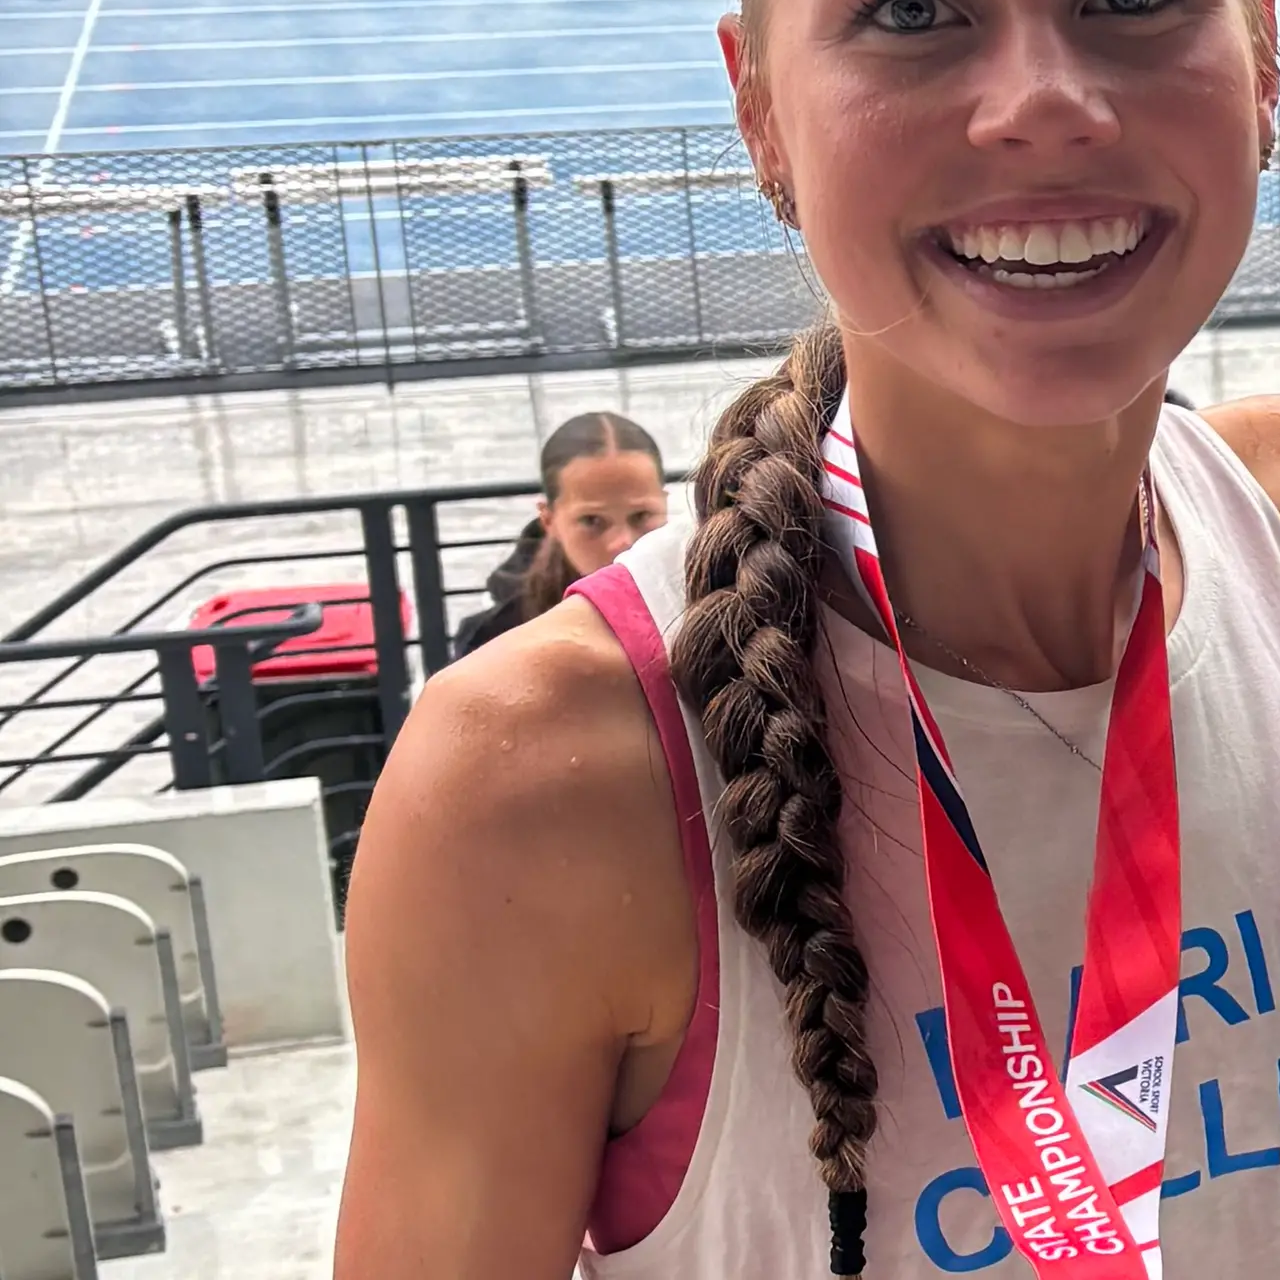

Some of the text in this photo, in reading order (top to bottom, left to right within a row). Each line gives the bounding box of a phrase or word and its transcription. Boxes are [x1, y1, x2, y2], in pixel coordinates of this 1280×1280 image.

[1139, 1058, 1153, 1103] VICTORIA
[1153, 1056, 1164, 1088] SCHOOL
[992, 981, 1125, 1256] CHAMPIONSHIP
[1002, 1175, 1078, 1262] STATE
